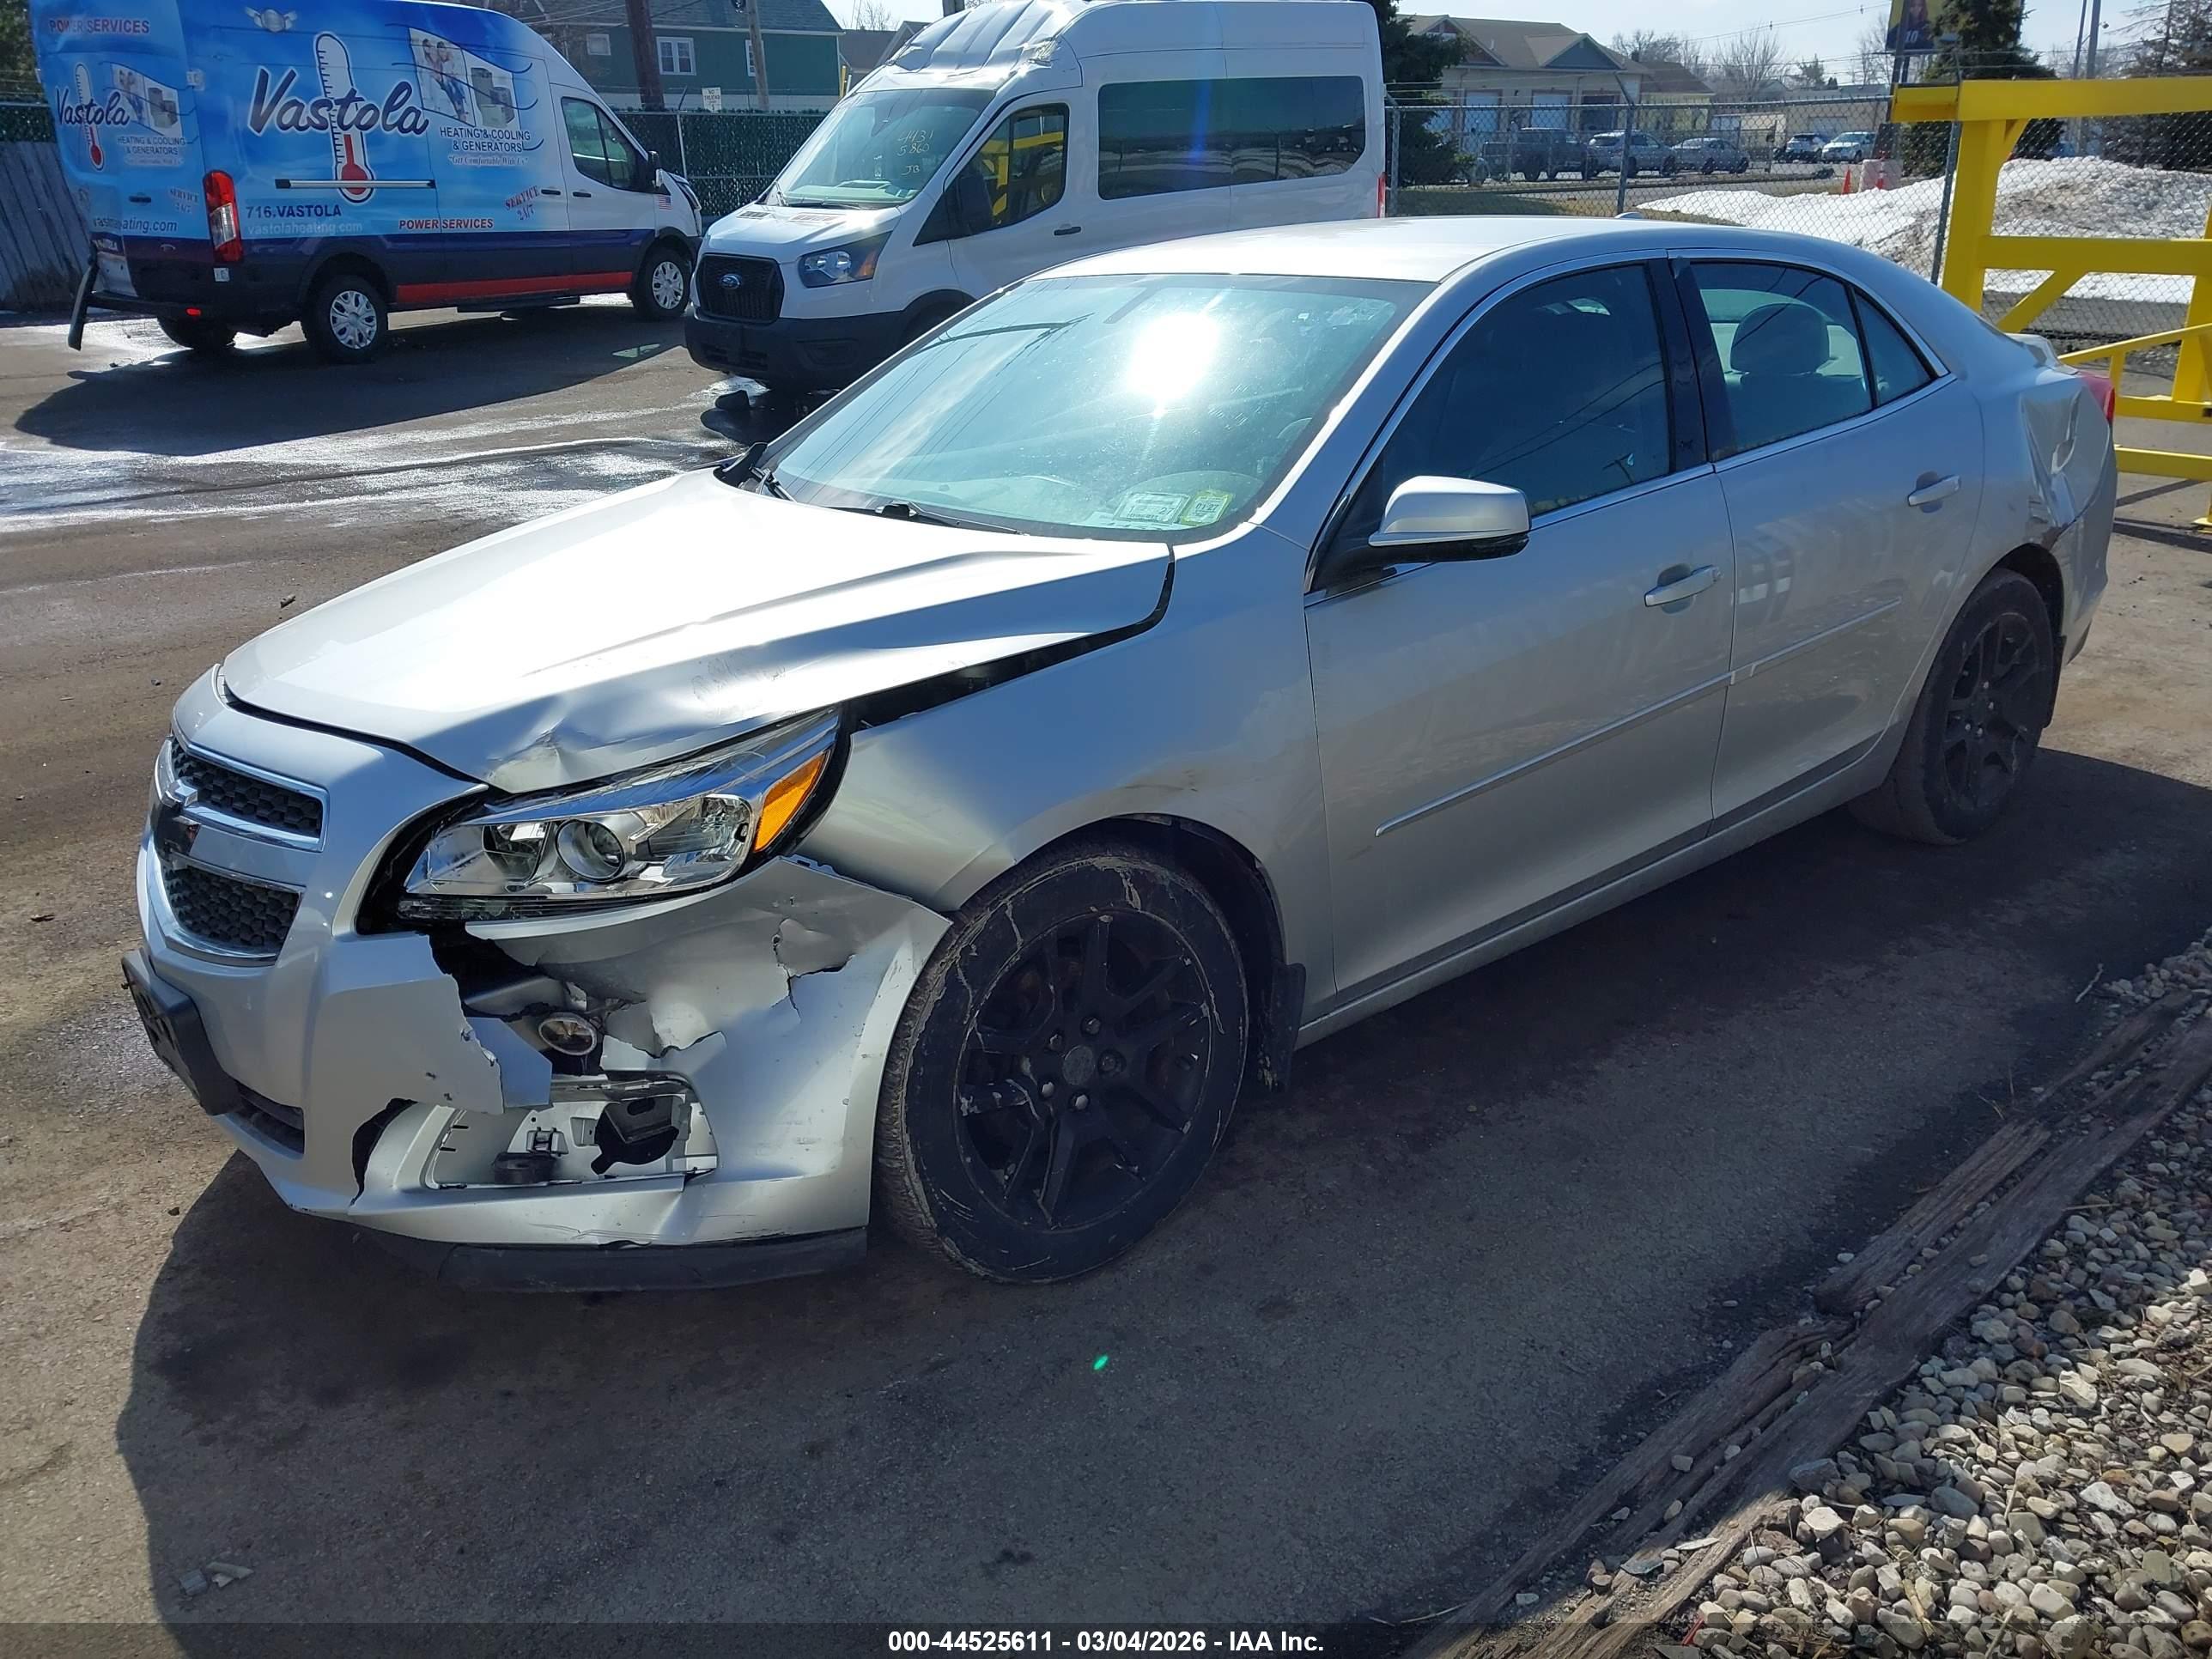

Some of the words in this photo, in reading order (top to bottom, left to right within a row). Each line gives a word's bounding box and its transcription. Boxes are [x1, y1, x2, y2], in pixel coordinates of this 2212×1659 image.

[87, 19, 150, 33] SERVICES
[56, 88, 130, 125] Vastola
[250, 68, 428, 135] Vastola
[440, 127, 480, 139] HEATING
[483, 129, 489, 139] &
[490, 130, 531, 141] COOLING
[117, 137, 145, 145] HEATING
[152, 137, 185, 146] COOLING
[453, 140, 459, 150] &
[461, 141, 522, 153] GENERATORS
[131, 146, 179, 155] GENERATORS
[505, 185, 540, 211] SERVICE
[246, 204, 342, 219] 716.VASTOLA
[247, 221, 363, 234] vastolaheating.com
[399, 219, 439, 229] POWER
[441, 218, 494, 229] SERVICES
